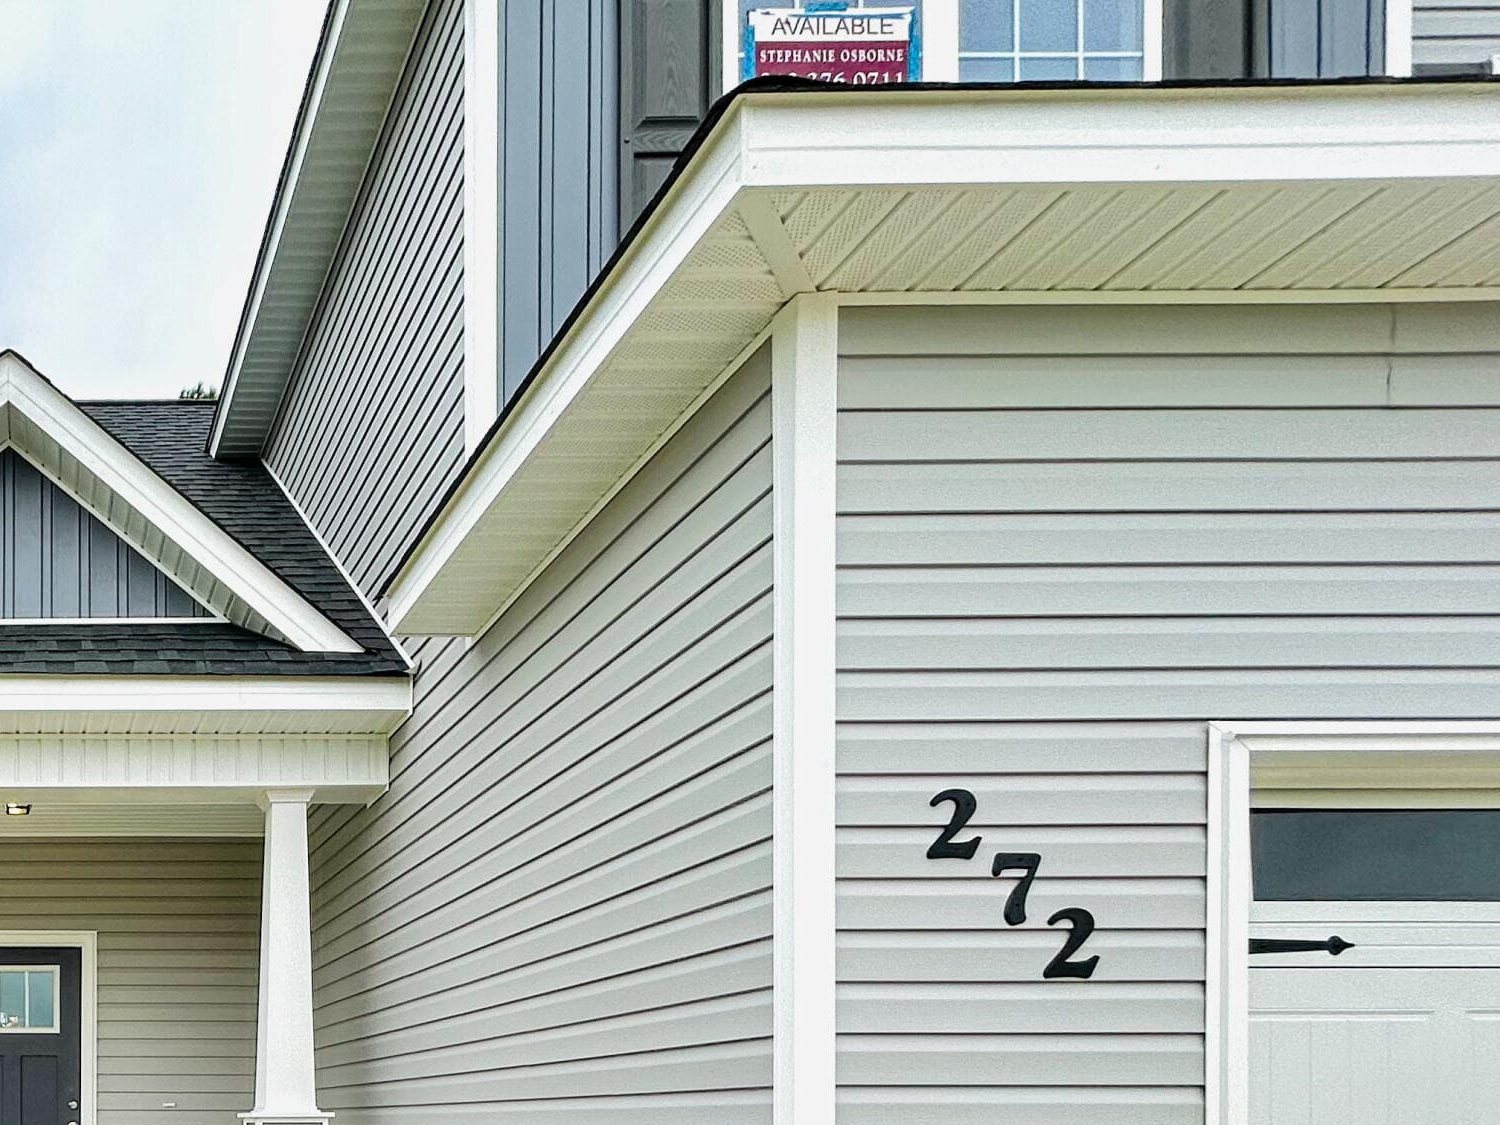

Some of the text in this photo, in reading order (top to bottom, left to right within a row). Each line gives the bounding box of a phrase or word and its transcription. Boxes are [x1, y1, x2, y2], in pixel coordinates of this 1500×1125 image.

[771, 17, 895, 35] AVAILABLE
[760, 49, 904, 63] STEPHANIE OSBORNE
[926, 788, 1100, 979] 272
